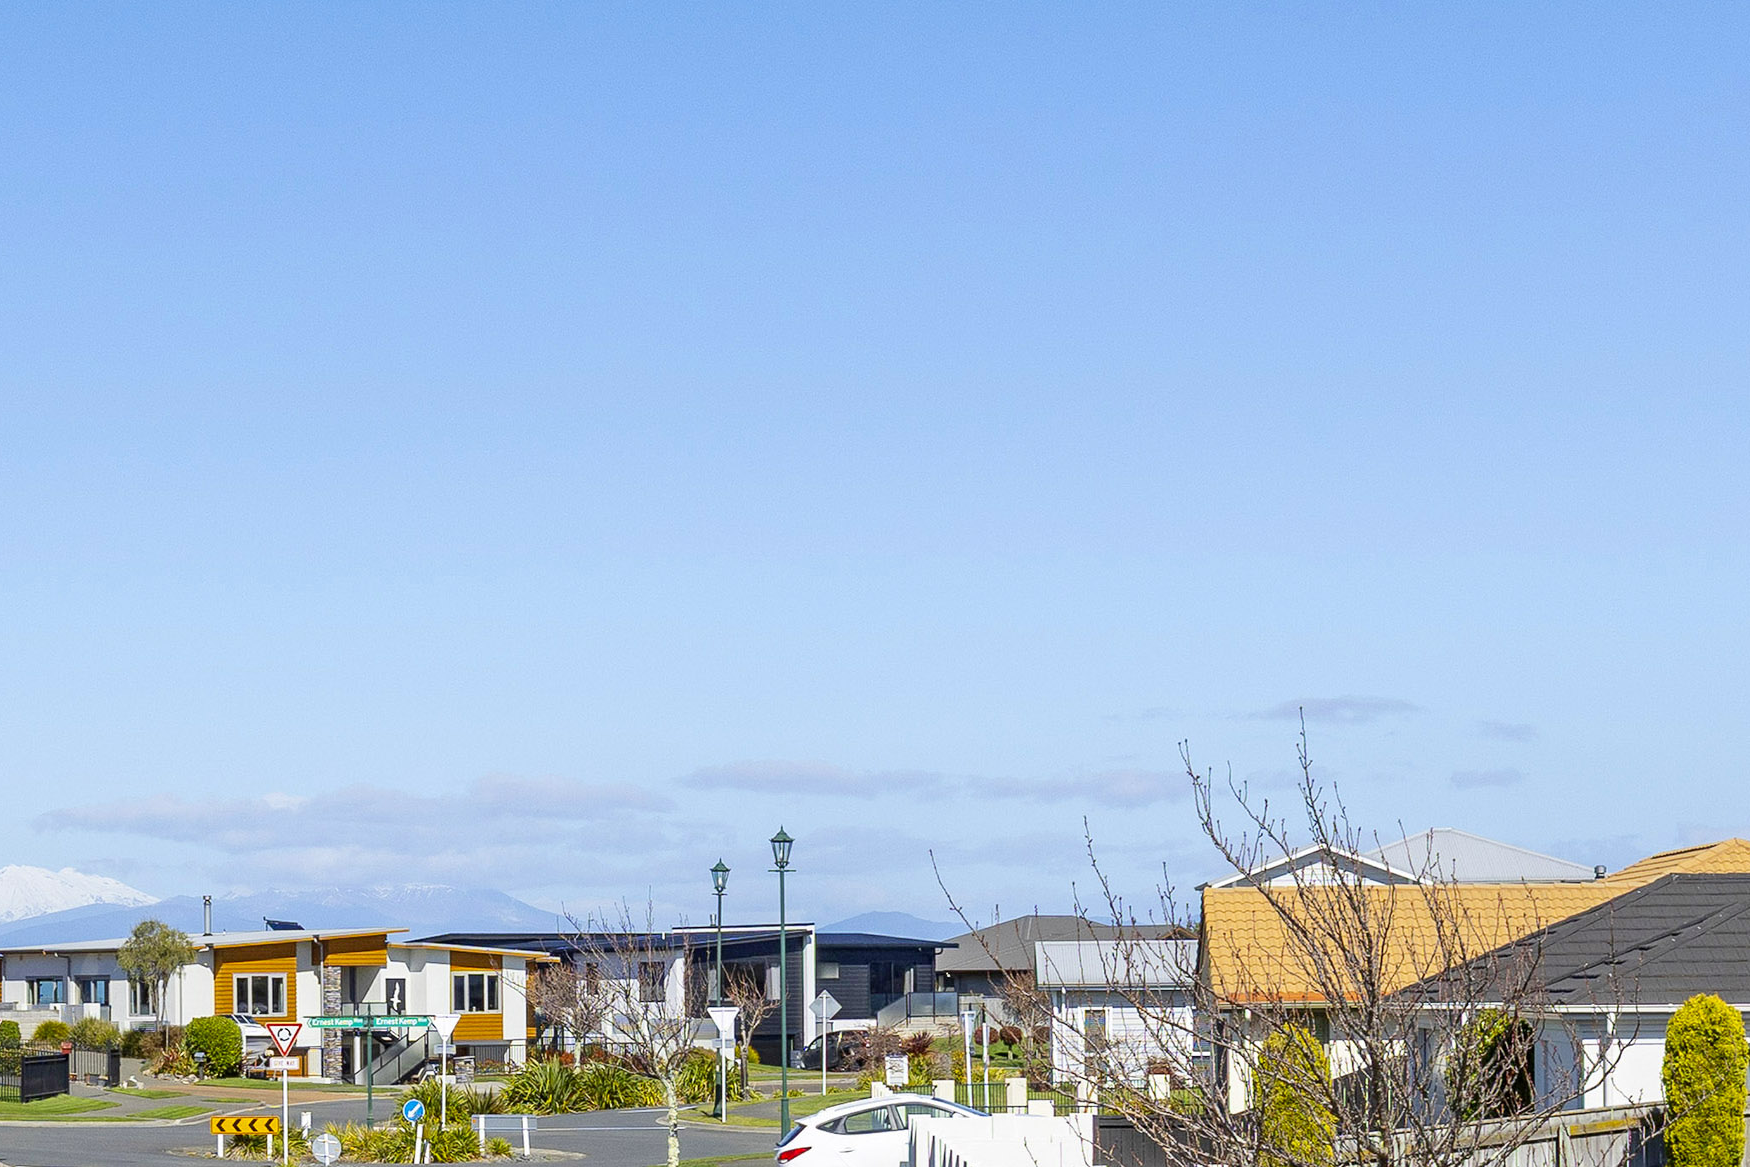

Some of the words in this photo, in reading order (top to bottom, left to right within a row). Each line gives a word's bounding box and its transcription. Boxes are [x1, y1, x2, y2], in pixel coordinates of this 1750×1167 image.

[312, 1018, 334, 1026] Ernest
[335, 1018, 353, 1027] Kemp
[376, 1017, 398, 1025] Ernest
[399, 1017, 417, 1026] Kemp
